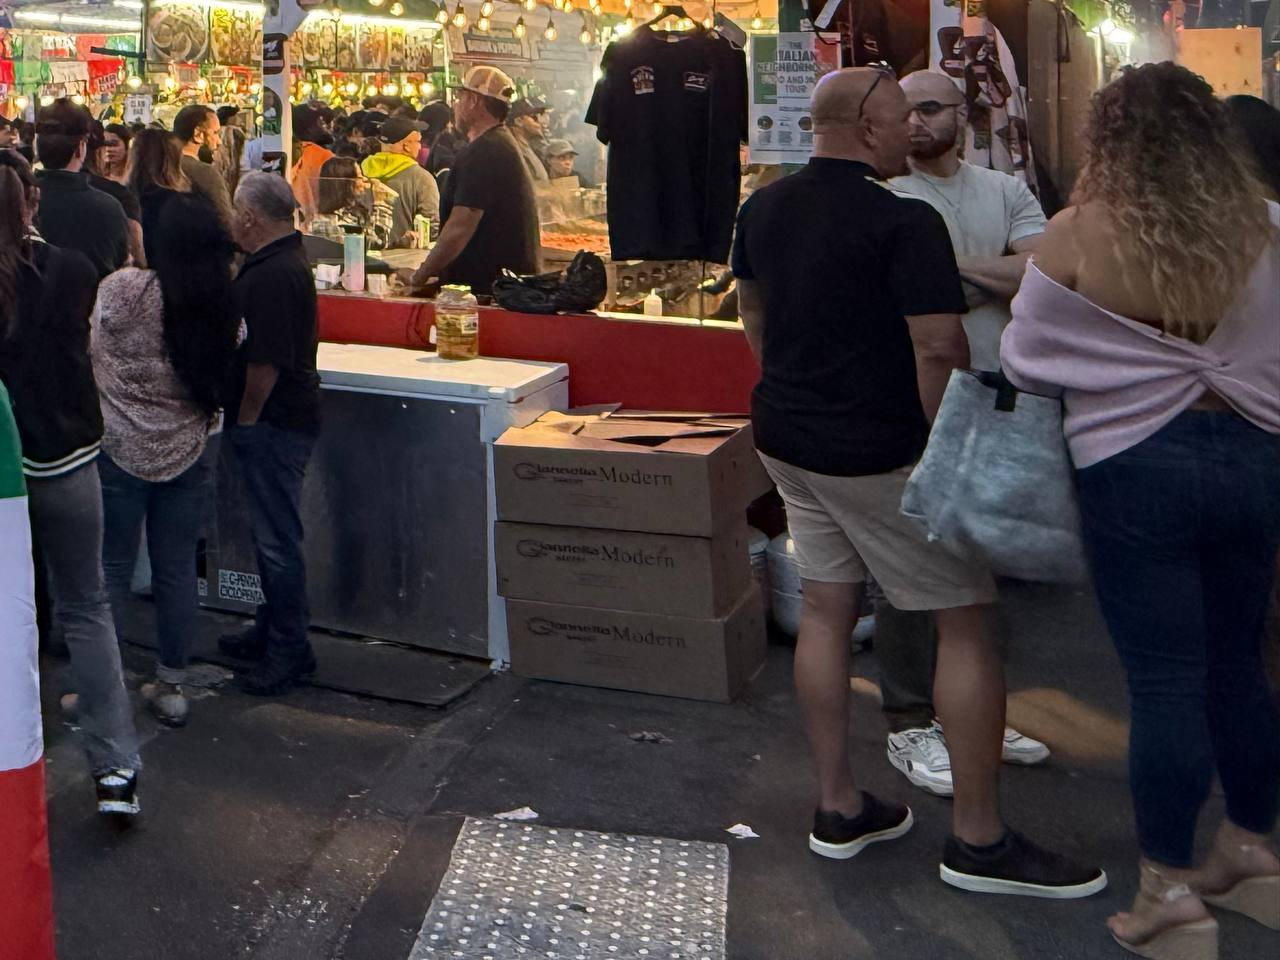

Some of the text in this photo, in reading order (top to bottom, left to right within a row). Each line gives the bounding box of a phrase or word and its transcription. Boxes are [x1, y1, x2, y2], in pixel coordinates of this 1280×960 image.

[776, 50, 817, 61] ITALIAN
[599, 466, 673, 487] Modern
[601, 544, 675, 568] Modern
[612, 624, 687, 649] Modern
